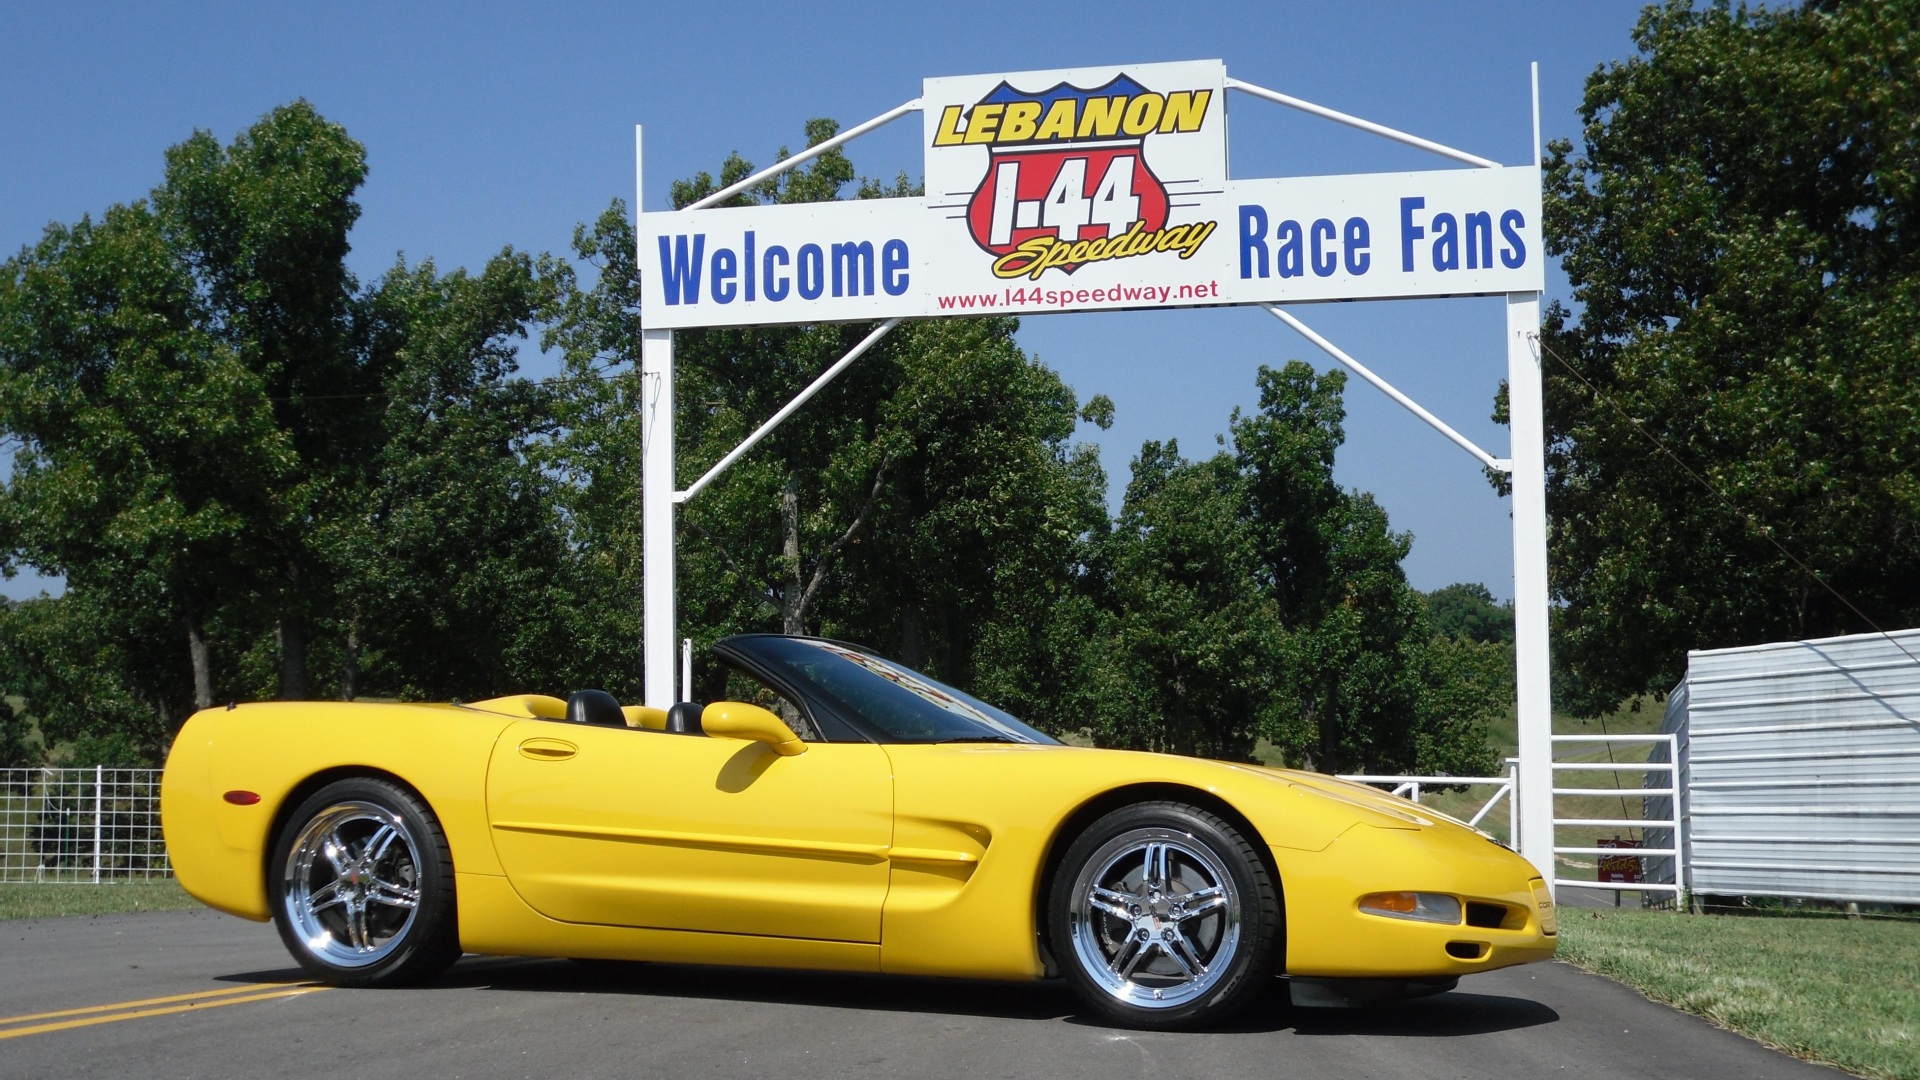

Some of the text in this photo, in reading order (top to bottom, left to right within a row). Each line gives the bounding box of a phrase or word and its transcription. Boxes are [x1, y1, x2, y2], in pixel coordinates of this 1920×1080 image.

[932, 89, 1213, 148] LEBANON
[988, 155, 1142, 247] I-44
[658, 196, 1526, 306] Welcome Race Fans
[992, 219, 1218, 280] Speedway
